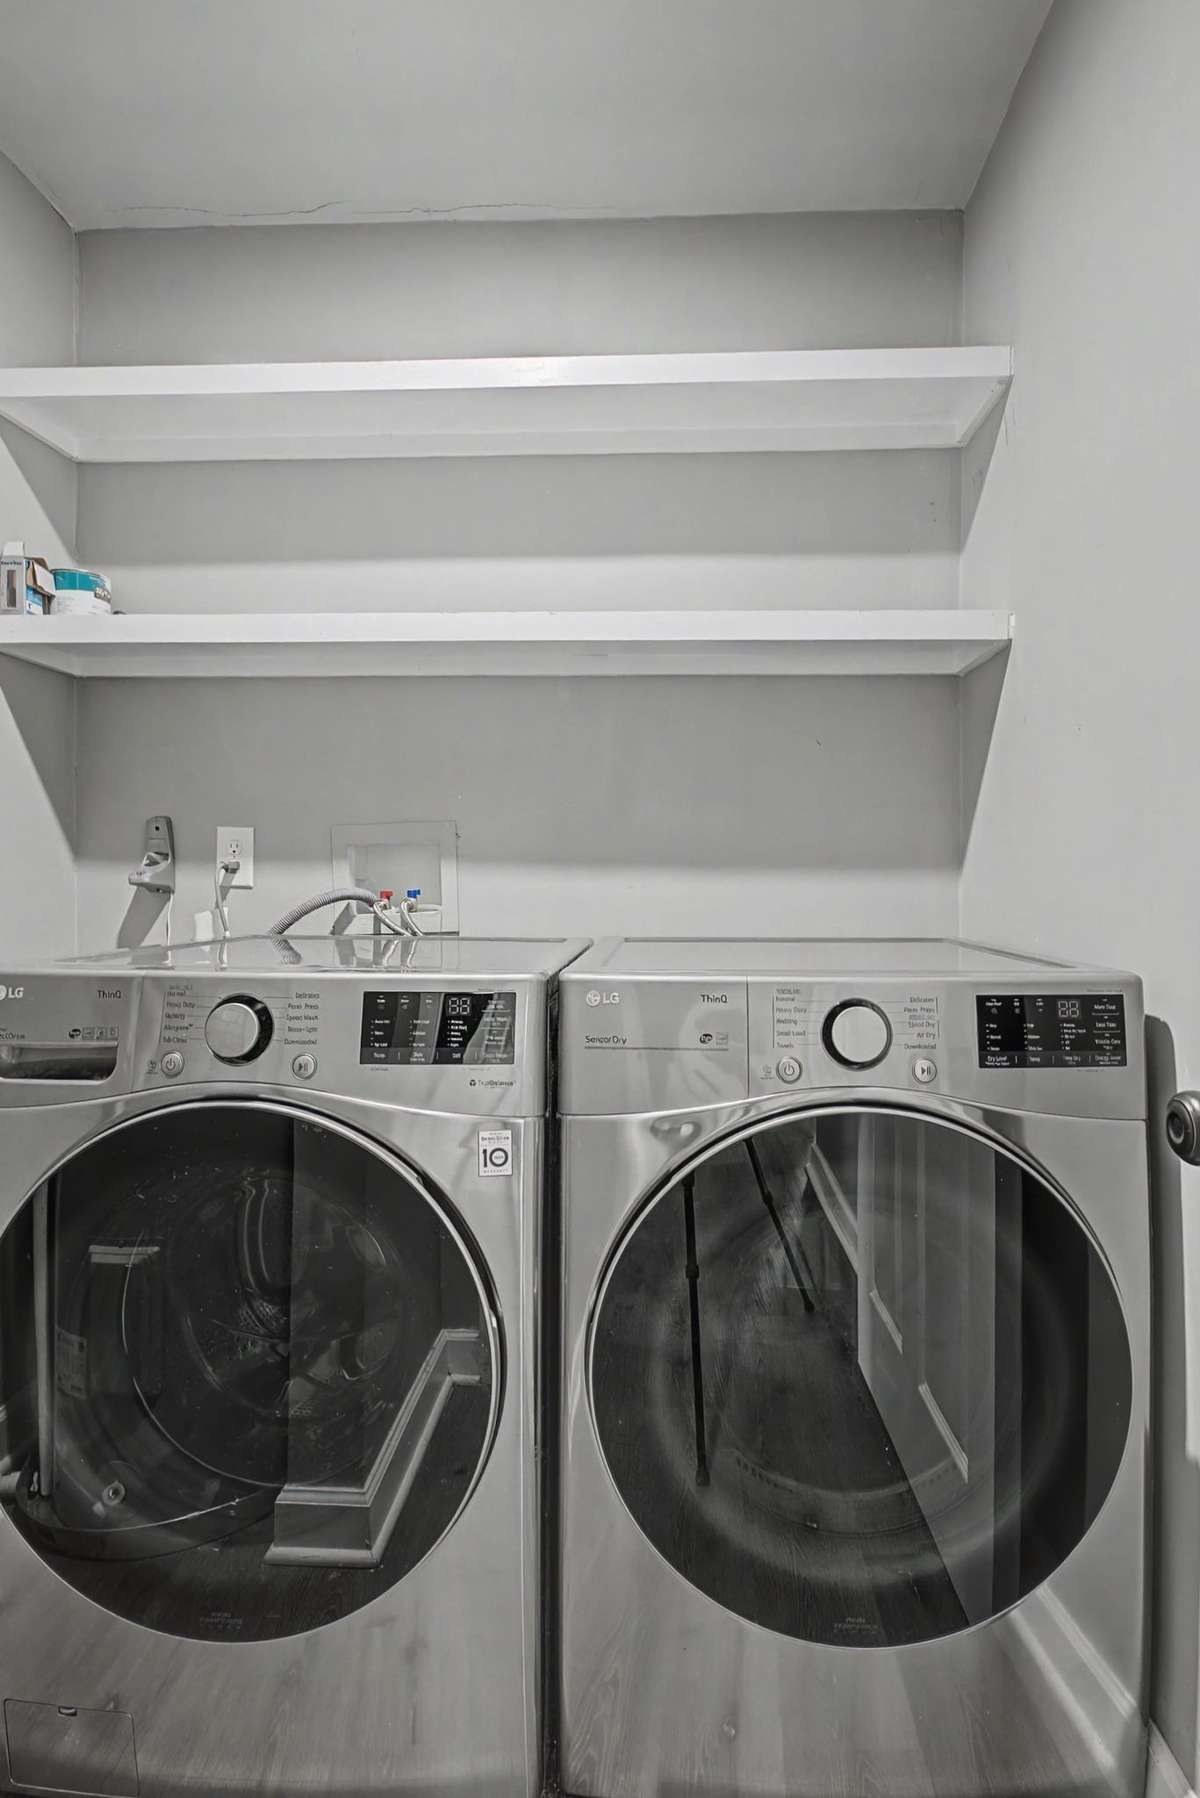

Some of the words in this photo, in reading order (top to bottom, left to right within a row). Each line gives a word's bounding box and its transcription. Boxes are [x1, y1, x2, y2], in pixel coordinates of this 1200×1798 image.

[8, 987, 24, 999] LG
[97, 990, 122, 999] ThinQ
[602, 992, 620, 1004] LG
[700, 994, 727, 1004] ThinQ
[926, 1032, 936, 1040] Dry
[482, 1147, 508, 1168] 10
